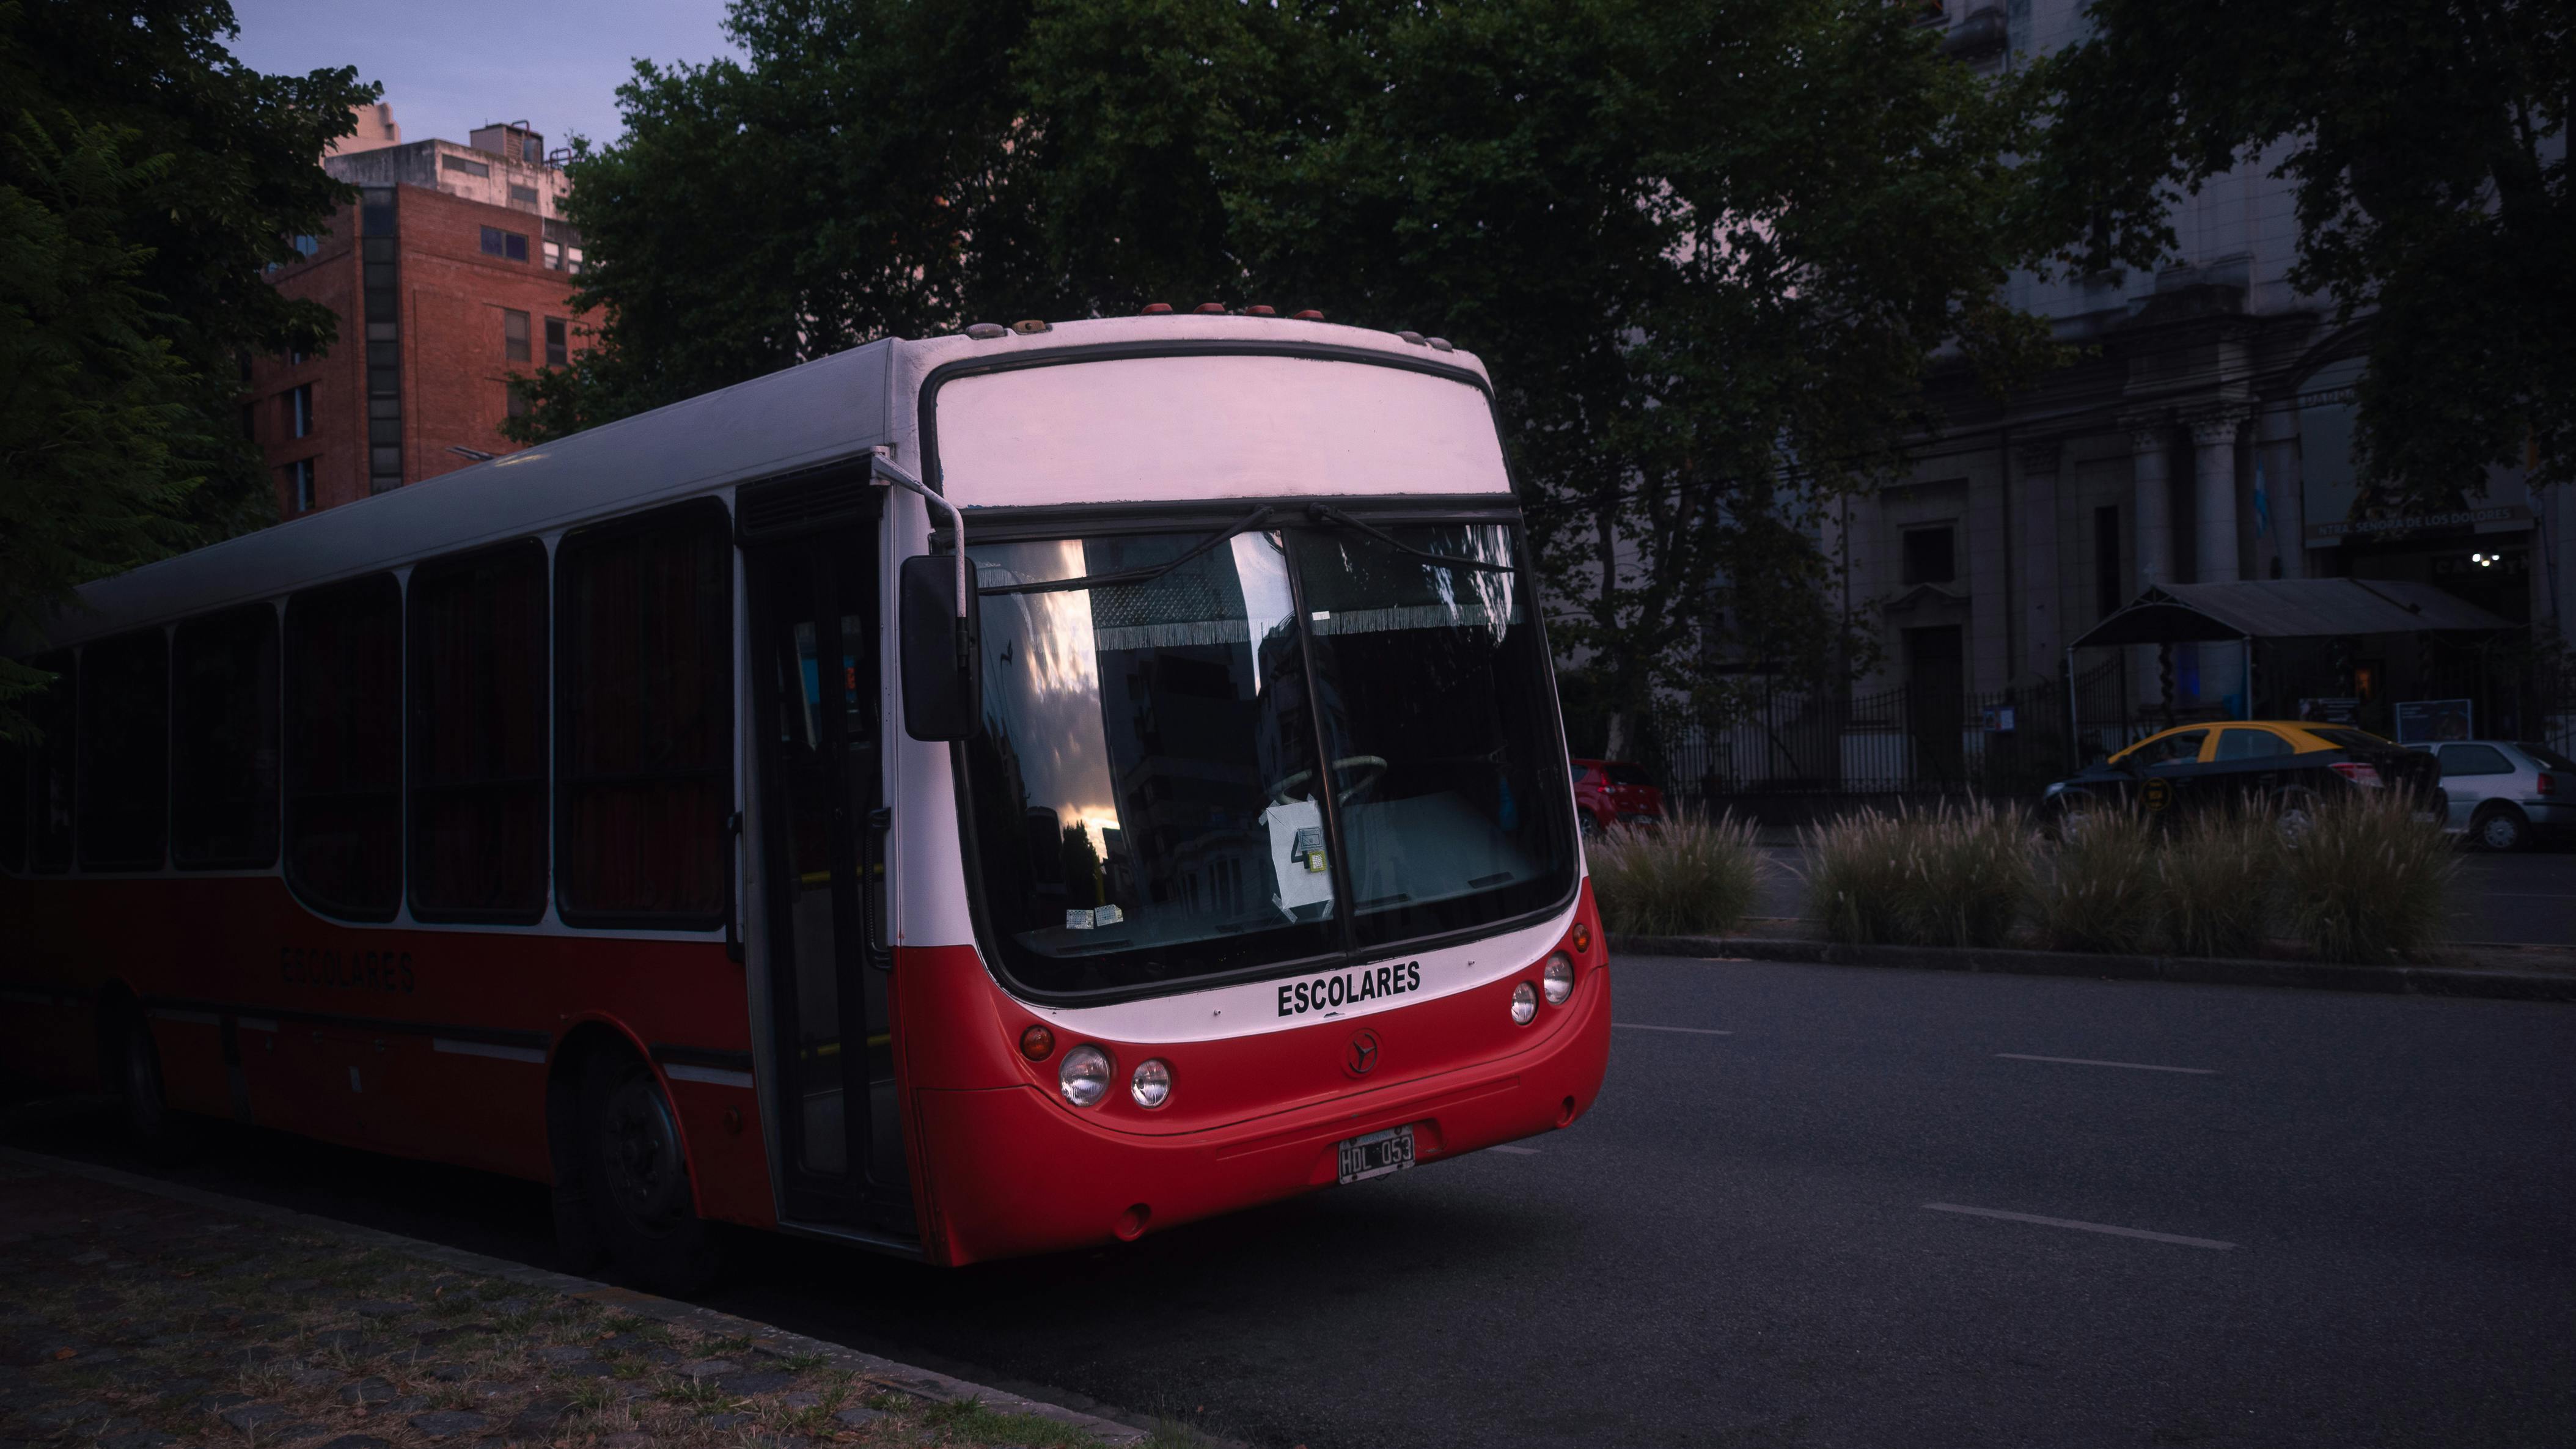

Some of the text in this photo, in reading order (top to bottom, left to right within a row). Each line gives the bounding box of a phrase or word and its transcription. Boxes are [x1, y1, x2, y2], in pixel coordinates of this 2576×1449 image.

[2405, 516, 2423, 528] DE
[2425, 513, 2448, 526] LOS
[2451, 508, 2511, 524] DOLORES
[281, 947, 414, 993] ESCOLARES
[1278, 961, 1420, 1016] ESCOLARES
[1341, 1137, 1412, 1175] HDL 053
